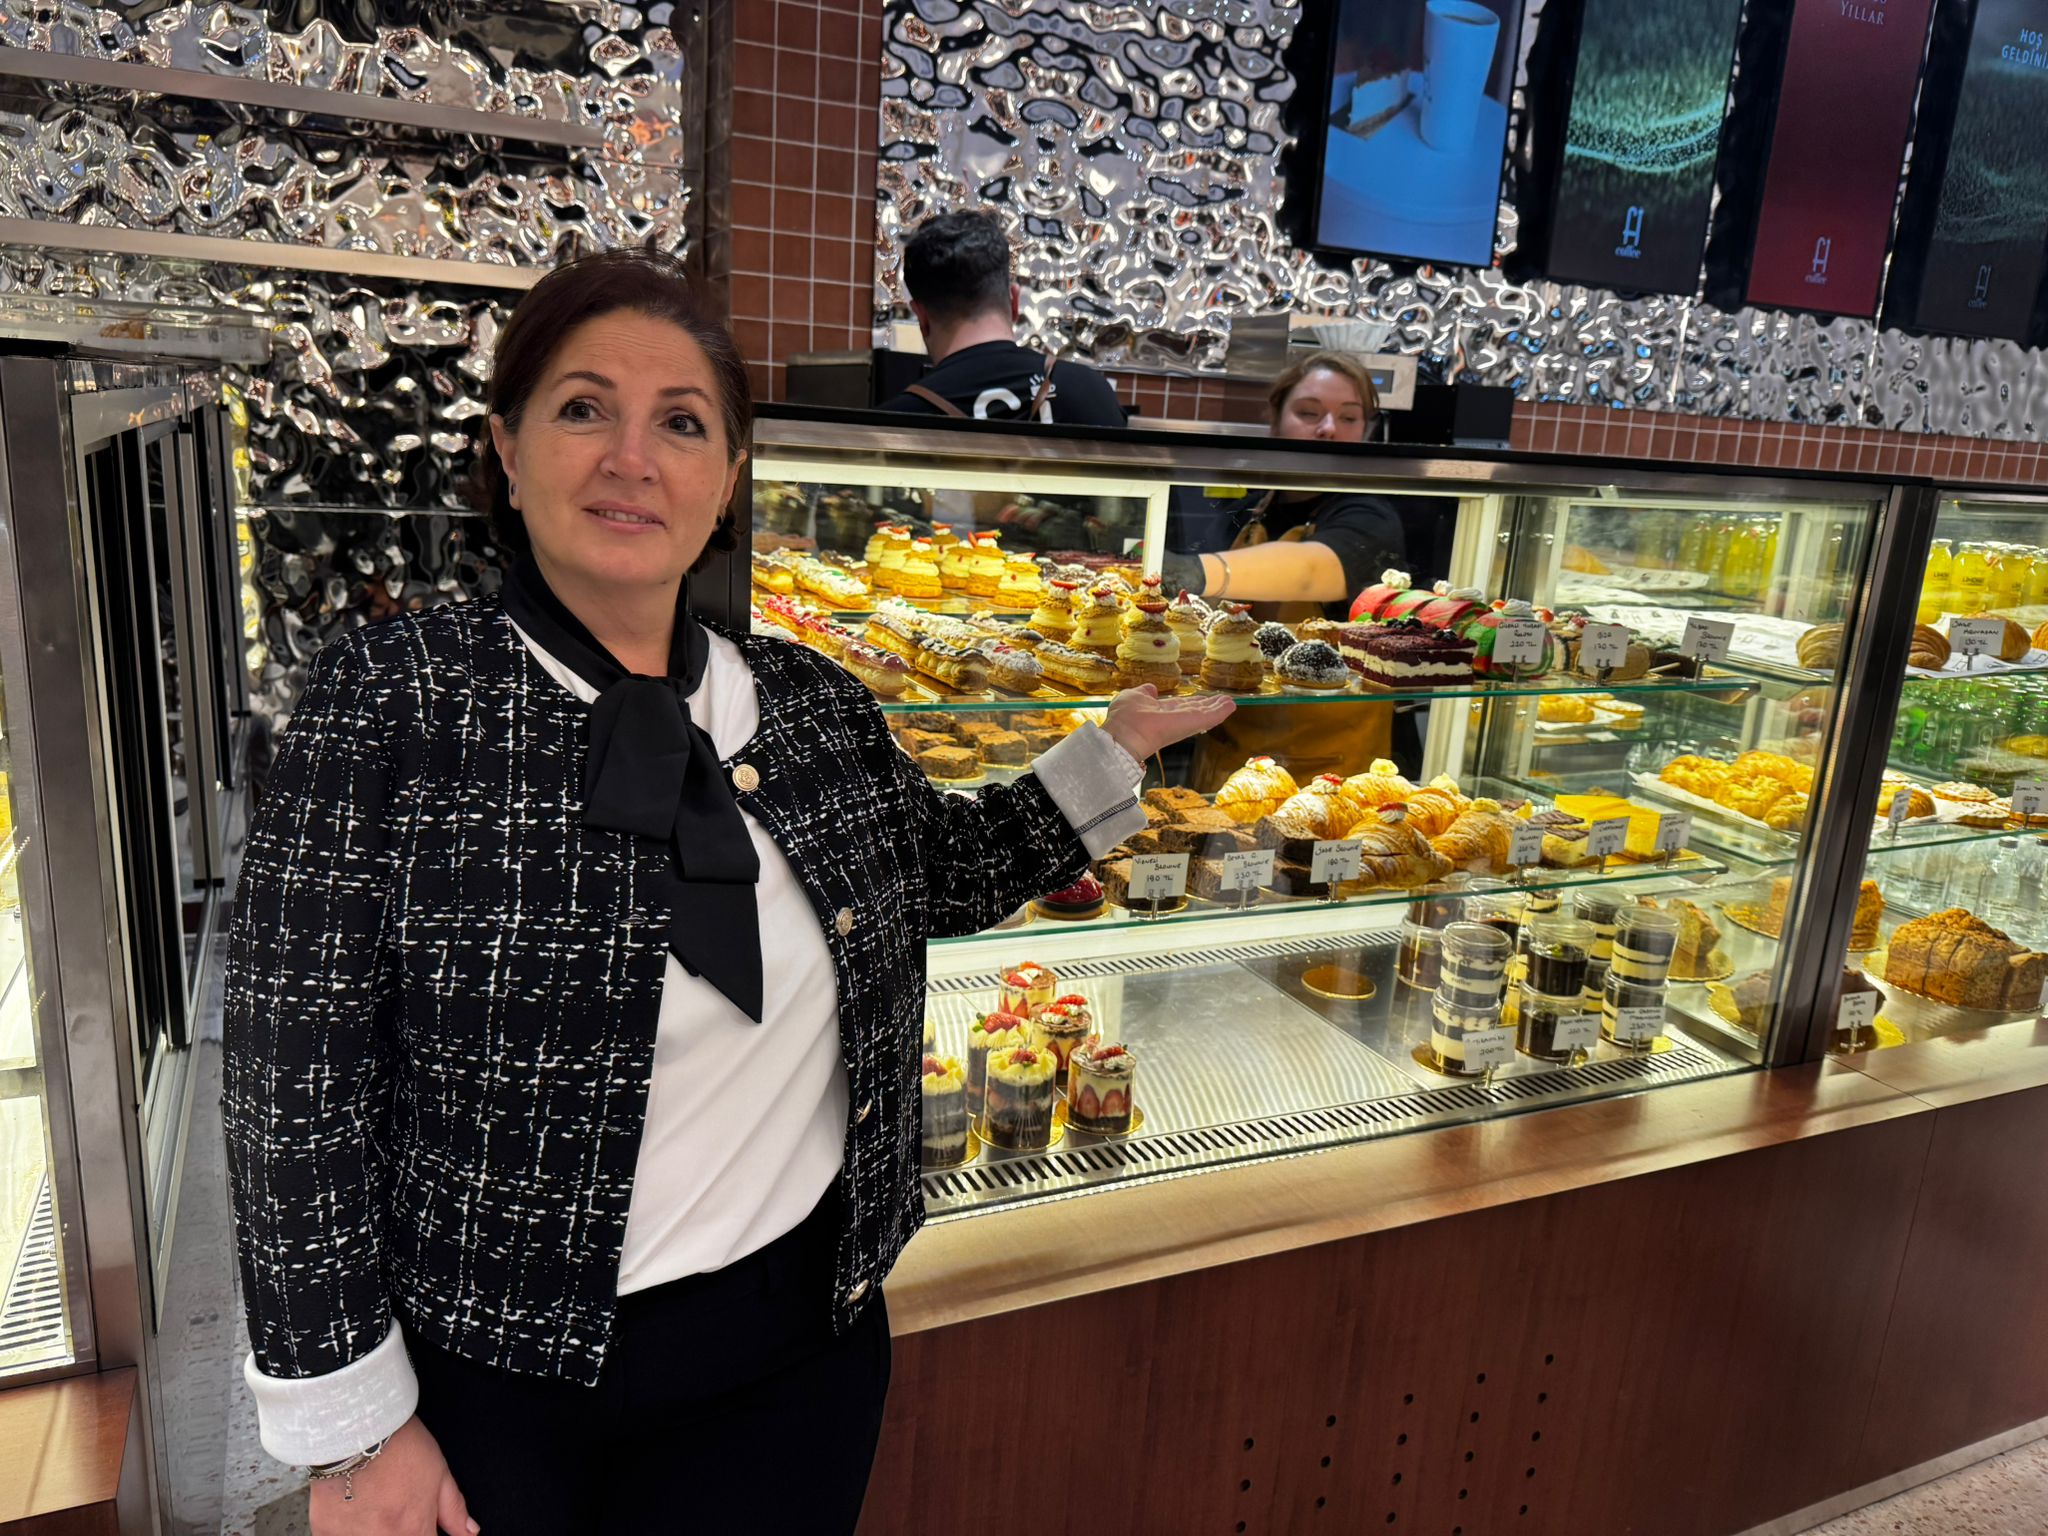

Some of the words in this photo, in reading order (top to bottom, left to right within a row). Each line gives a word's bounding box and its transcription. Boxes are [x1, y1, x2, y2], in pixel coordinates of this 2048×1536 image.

[1840, 0, 1885, 25] YILLAR
[2019, 28, 2044, 51] HOŞ
[2001, 44, 2048, 69] GELDİNİ
